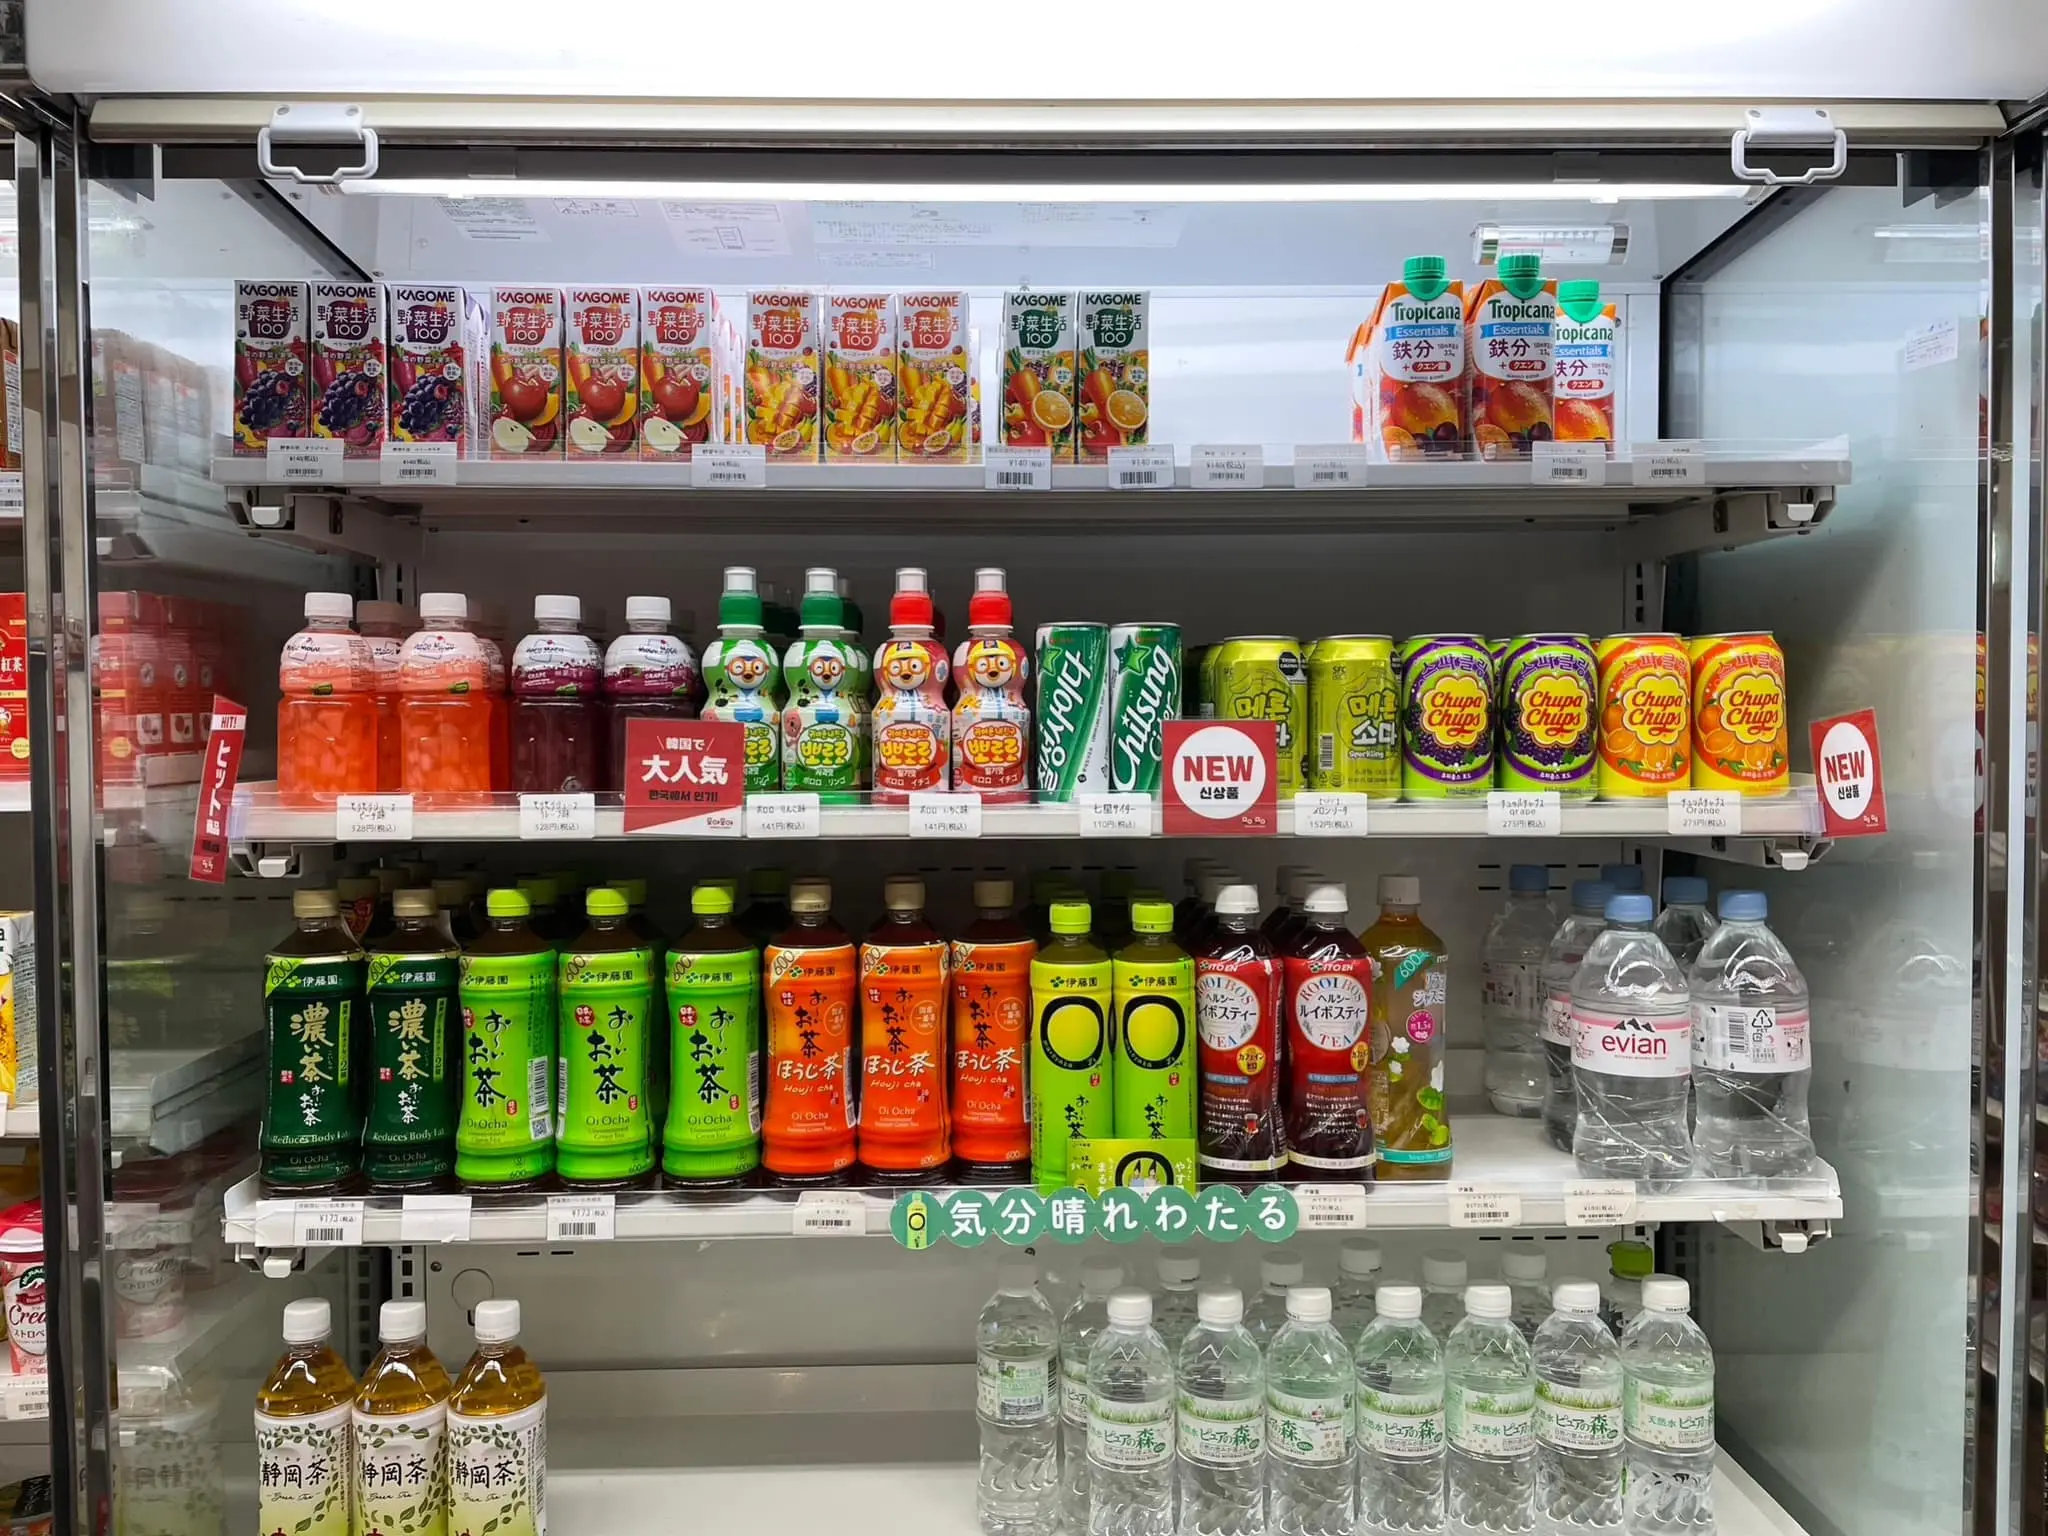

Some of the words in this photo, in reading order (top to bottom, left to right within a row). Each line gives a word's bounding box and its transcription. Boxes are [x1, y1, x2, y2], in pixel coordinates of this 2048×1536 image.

[239, 284, 298, 297] KAGOME
[317, 285, 376, 299] KAGOME
[397, 289, 455, 303] KAGOME
[648, 290, 704, 304] KAGOME
[496, 291, 553, 305] KAGOME
[573, 291, 630, 305] KAGOME
[752, 295, 809, 308] KAGOME
[831, 296, 887, 309] KAGOME
[903, 295, 959, 308] KAGOME
[1011, 295, 1067, 307] KAGOME
[1086, 294, 1142, 305] KAGOME
[239, 304, 299, 323] 野菜生活
[317, 305, 377, 324] 野菜生活
[1391, 302, 1461, 323] Tropicana
[1488, 300, 1555, 321] Tropicana
[397, 309, 456, 328] 野菜生活
[496, 311, 554, 329] 野菜生活
[573, 312, 632, 328] 野菜生活
[647, 311, 705, 328] 野菜生活
[752, 314, 809, 333] 野菜生活
[831, 316, 888, 335] 野菜生活
[903, 315, 960, 333] 野菜生活
[1011, 315, 1067, 332] 野菜生活
[1086, 314, 1142, 331] 野菜生活
[256, 323, 284, 336] 100
[334, 324, 362, 337] 100
[414, 328, 441, 340] 100
[512, 329, 539, 342] 100
[589, 329, 616, 342] 100
[663, 328, 690, 341] 100
[1395, 326, 1449, 338] Essentials
[1492, 325, 1544, 336] Essentials
[768, 333, 794, 345] 100
[847, 335, 872, 346] 100
[919, 334, 945, 345] 100
[1026, 332, 1052, 344] 100
[1101, 331, 1127, 344] 100
[1391, 339, 1435, 360] 鉄分
[1488, 338, 1531, 358] 鉄分
[1, 657, 24, 672] 紅茶
[1431, 691, 1482, 713] Chupa
[1529, 690, 1583, 712] Chupa
[1631, 690, 1684, 711] Chupa
[1729, 690, 1779, 710] Chupa
[221, 716, 237, 729] HIT!
[1111, 644, 1178, 793] Chilsung
[1428, 709, 1481, 736] Chups
[1526, 709, 1581, 736] Chups
[1628, 708, 1682, 736] Chups
[1726, 707, 1779, 735] Chups
[1351, 718, 1397, 746] 소다
[666, 737, 705, 751] 韓国で
[801, 740, 849, 766] 뽀로로
[881, 740, 932, 766] 뽀로로
[967, 739, 1020, 765] 뽀로로
[1348, 750, 1384, 760] Sparkling
[641, 754, 728, 786] 大人気
[1183, 755, 1254, 782] NEW
[1824, 750, 1865, 784] NEW
[649, 790, 691, 801] 한국에서
[1200, 786, 1240, 800] 신상품
[1837, 784, 1860, 800] 신상품
[1093, 804, 1136, 814] 七星サイダー
[1686, 806, 1720, 815] Orange
[761, 823, 805, 831] 141円(税込)
[924, 823, 967, 831] 141円(税込)
[803, 966, 836, 976] 伊藤園
[890, 964, 922, 975] 伊藤園
[975, 962, 1005, 972] 伊藤園
[1401, 953, 1423, 978] 600
[302, 974, 338, 987] 伊藤園
[400, 971, 436, 983] 伊藤園
[475, 975, 509, 986] 伊藤園
[596, 971, 632, 982] 伊藤園
[699, 971, 733, 982] 伊藤園
[1065, 977, 1098, 987] 伊藤園
[1144, 976, 1178, 987] 伊藤園
[1300, 976, 1362, 1002] ROOIBOS
[1205, 993, 1234, 1004] ヘルシー
[1318, 991, 1350, 1004] ヘルシー
[1300, 1004, 1366, 1021] ルイボスティー
[290, 1001, 334, 1083] 濃い茶
[388, 998, 430, 1081] 濃い茶
[1207, 1033, 1237, 1048] TEA
[1320, 1033, 1352, 1048] TEA
[1601, 1032, 1667, 1054] evian
[777, 1052, 843, 1080] ほうじ茶
[864, 1051, 935, 1077] ほうじ茶
[955, 1047, 1021, 1073] ほうじ茶
[870, 1079, 899, 1090] Houji
[904, 1079, 922, 1088] cha
[960, 1073, 986, 1085] Houji
[990, 1075, 1008, 1084] cha
[784, 1084, 814, 1096] Houji
[817, 1083, 835, 1092] cha
[879, 1106, 889, 1115] Oi
[892, 1106, 916, 1116] Ocha
[967, 1100, 976, 1109] Oi
[979, 1101, 1001, 1111] Ocha
[586, 1117, 600, 1126] Oi
[601, 1115, 630, 1126] Ocha
[688, 1116, 700, 1125] Oi
[703, 1114, 732, 1125] Ocha
[791, 1111, 803, 1120] Oi
[807, 1111, 829, 1121] Ocha
[272, 1133, 309, 1145] Reduces
[312, 1131, 334, 1144] Body
[372, 1133, 408, 1144] Reduces
[409, 1129, 432, 1143] Body
[950, 1198, 1288, 1239] 気分晴れわたる
[1555, 1415, 1609, 1436] ピュアの森
[1648, 1416, 1676, 1428] 天然水
[1200, 1425, 1250, 1447] ピュアの森
[1385, 1418, 1438, 1441] ピュアの森
[1472, 1423, 1501, 1436] 天然水
[1104, 1428, 1155, 1449] ピュアの森
[262, 1459, 330, 1488] 静岡茶
[455, 1459, 517, 1488] 静岡茶
